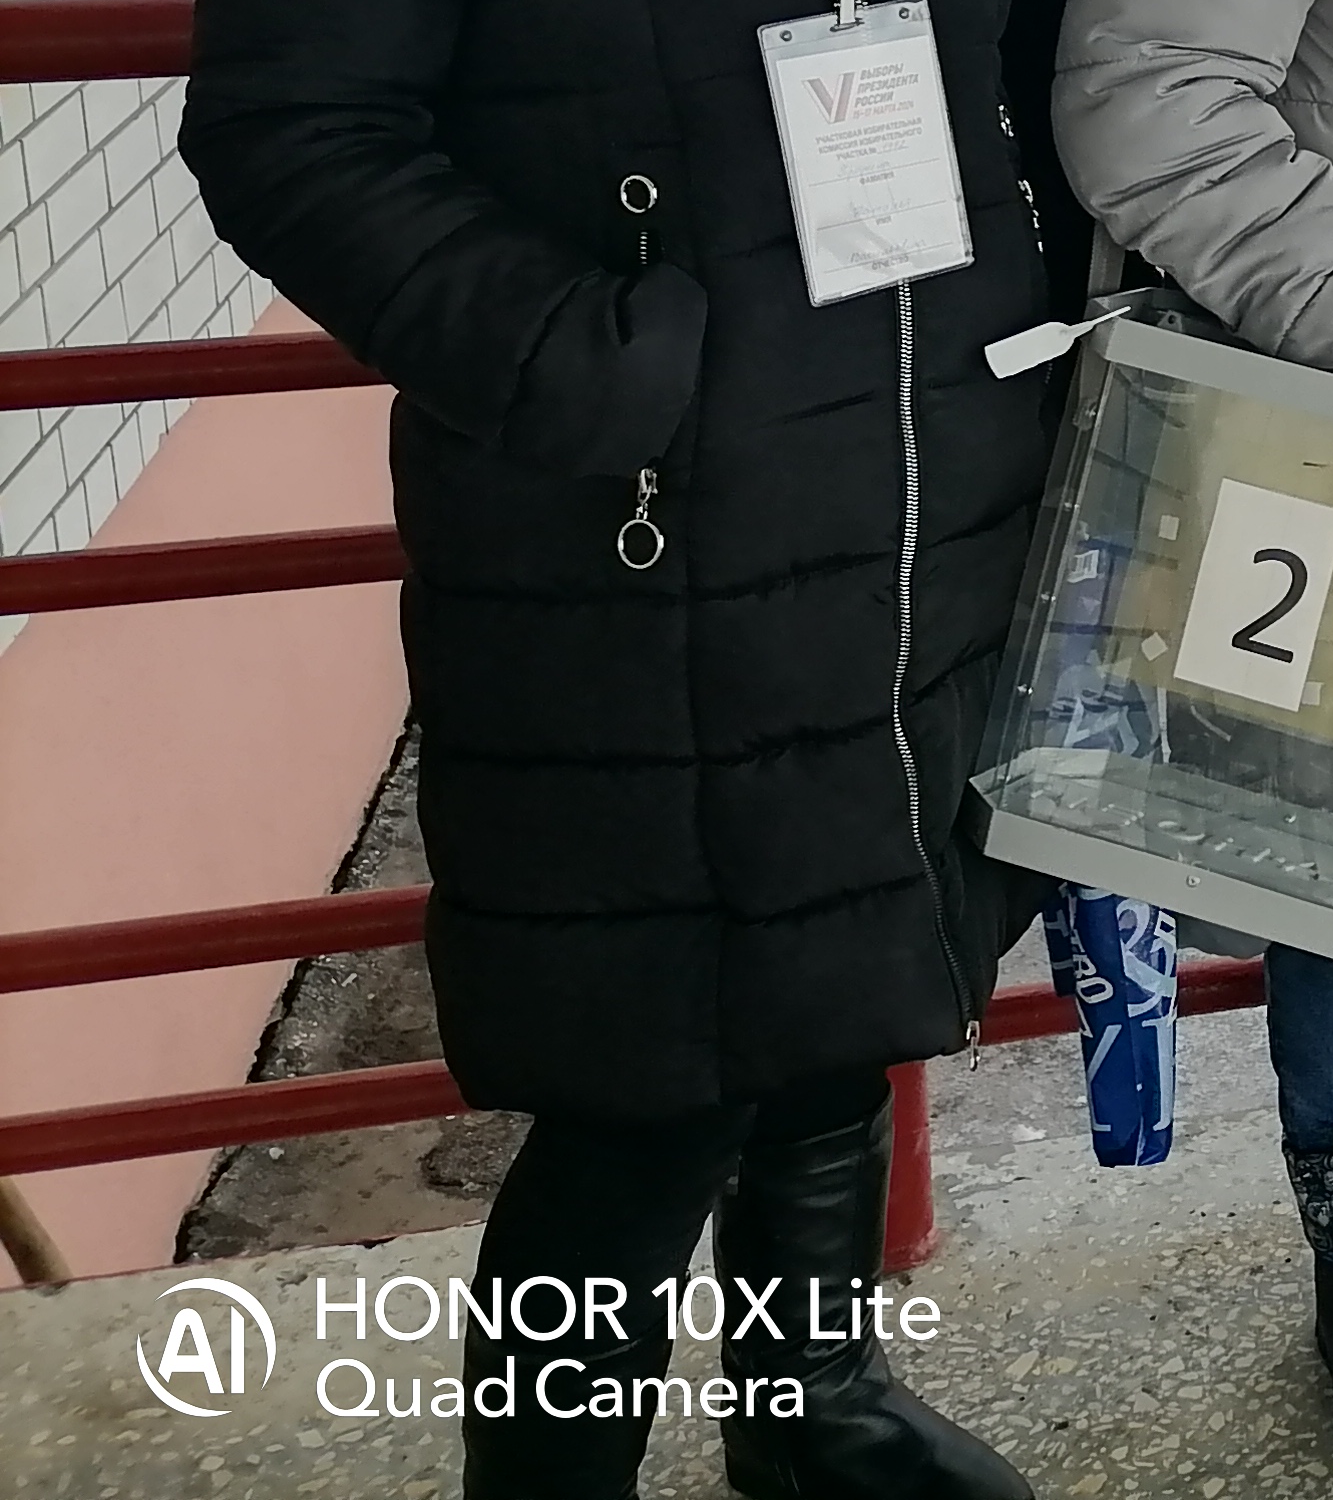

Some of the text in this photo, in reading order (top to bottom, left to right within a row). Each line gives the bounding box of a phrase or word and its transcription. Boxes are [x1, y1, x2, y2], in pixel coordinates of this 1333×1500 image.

[859, 62, 904, 81] ВЫБОРЫ
[856, 74, 919, 94] ПРЕЗИДЕНТА
[854, 91, 895, 108] РОССИИ
[1231, 547, 1310, 664] 2
